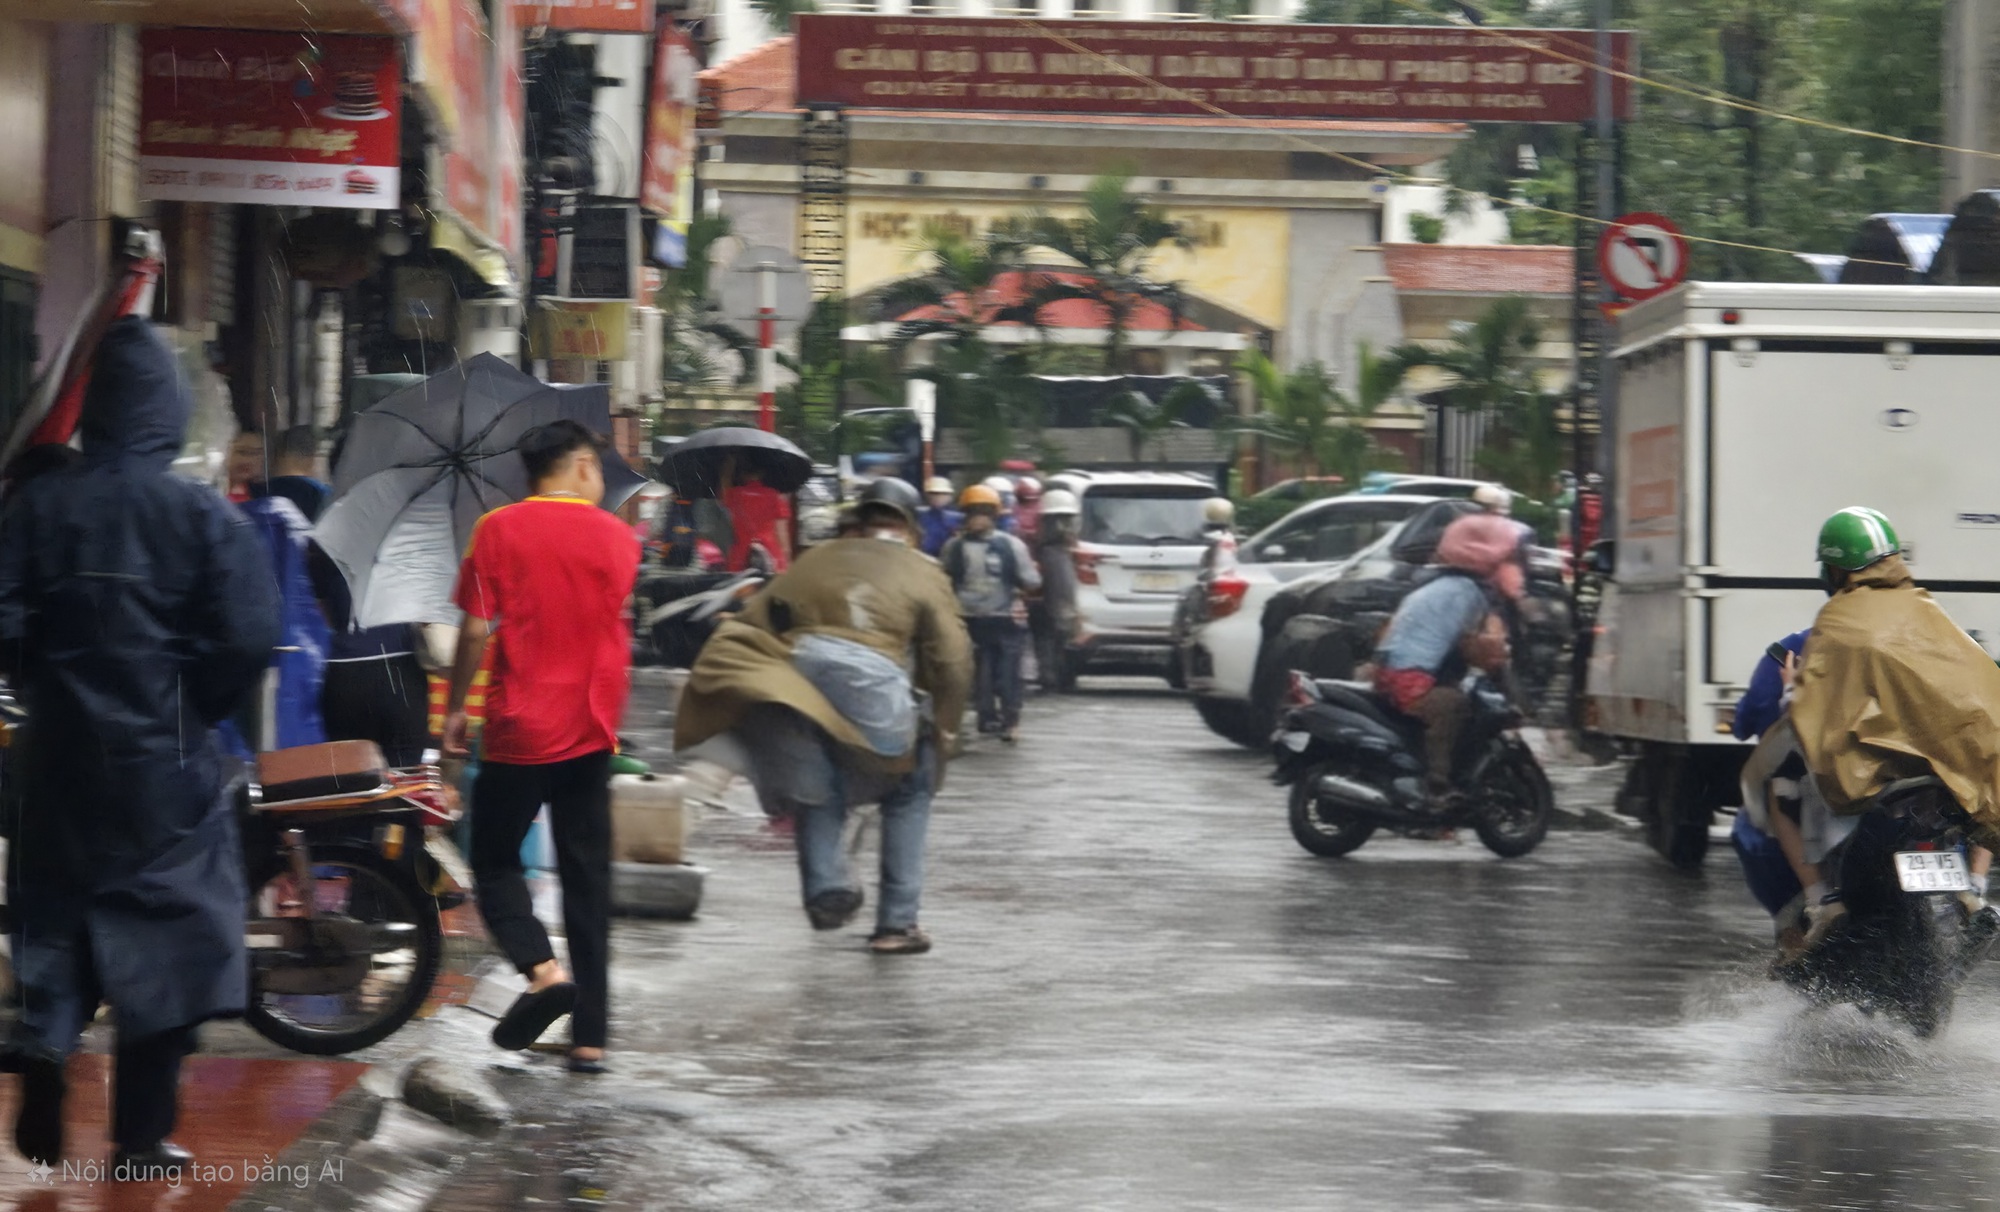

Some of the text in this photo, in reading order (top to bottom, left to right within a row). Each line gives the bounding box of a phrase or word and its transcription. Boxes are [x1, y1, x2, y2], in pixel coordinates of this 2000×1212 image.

[834, 43, 917, 71] CÁN
[922, 46, 980, 74] BỘ
[1159, 50, 1245, 78] DÂN
[1301, 53, 1386, 81] DÂN
[1389, 54, 1471, 84] PHỐ
[1472, 54, 1530, 84] SỐ
[1532, 62, 1586, 85] 02
